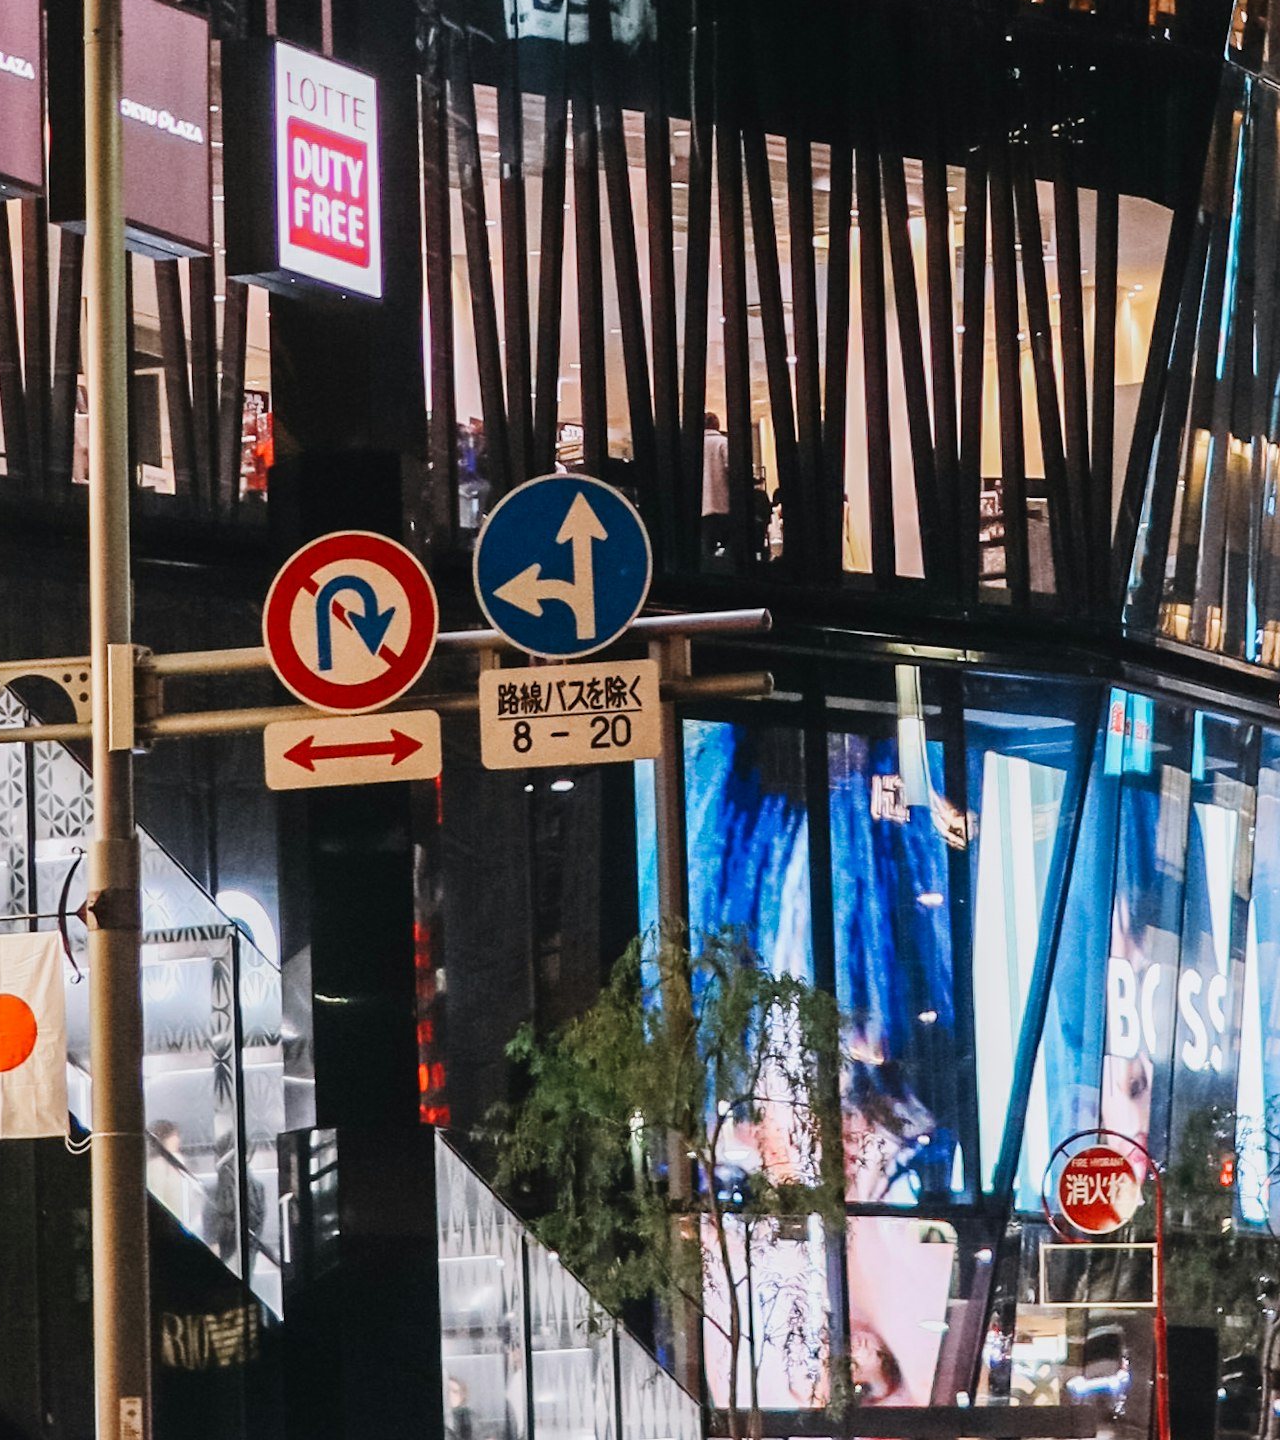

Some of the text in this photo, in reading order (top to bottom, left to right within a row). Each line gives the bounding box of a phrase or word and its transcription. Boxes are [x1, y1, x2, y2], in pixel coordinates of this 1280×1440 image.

[120, 97, 204, 144] OKYU PLAZA
[286, 71, 368, 131] LOTTE
[292, 136, 364, 199] DUTY
[293, 186, 365, 249] FREE
[497, 675, 642, 716] 路線バスを除く
[1071, 1158, 1089, 1168] FIRE
